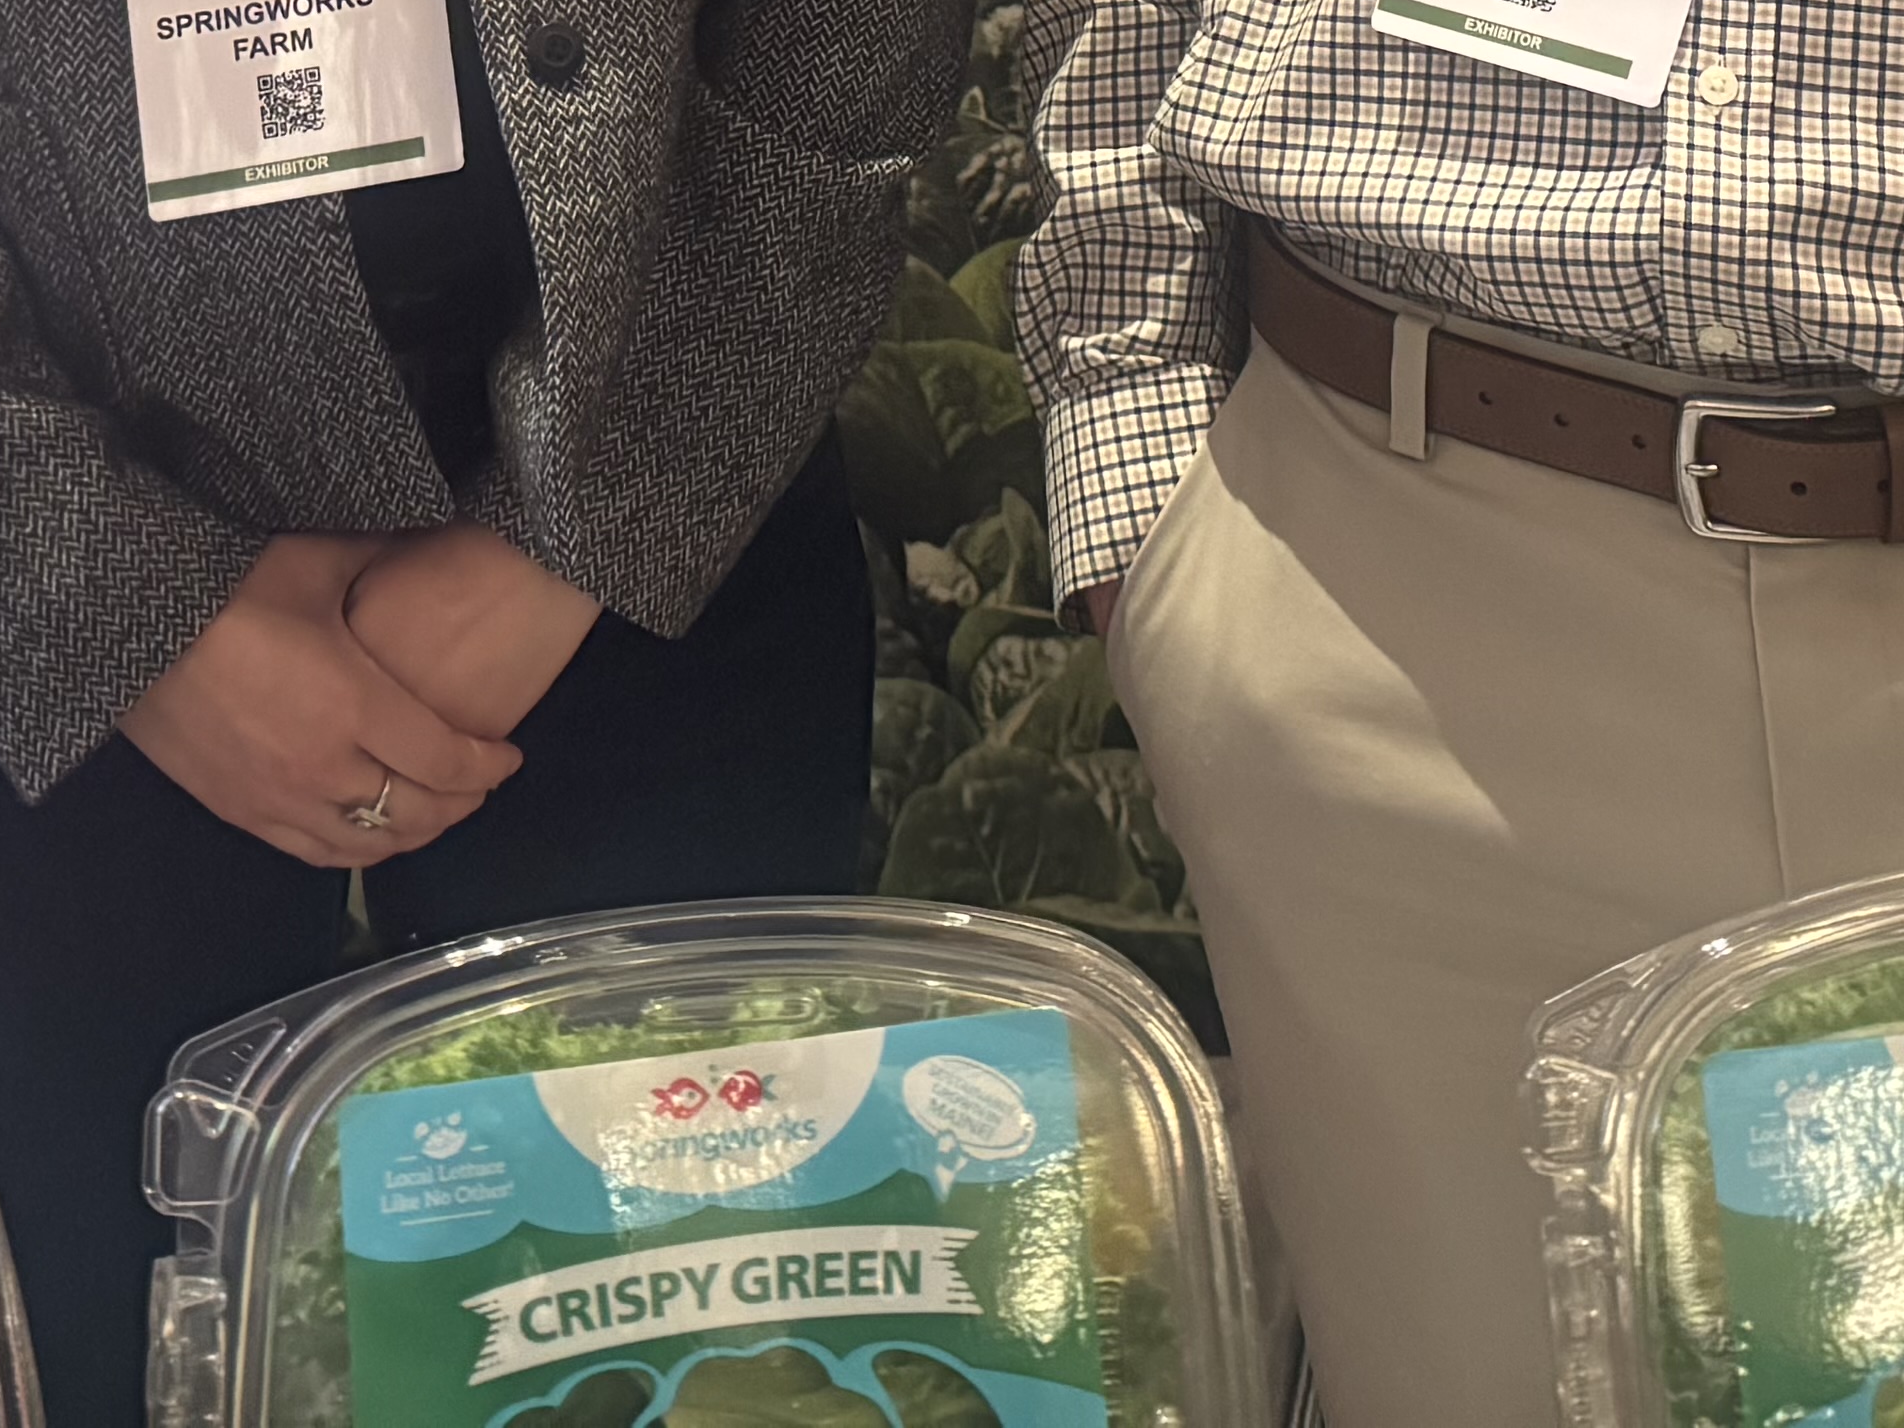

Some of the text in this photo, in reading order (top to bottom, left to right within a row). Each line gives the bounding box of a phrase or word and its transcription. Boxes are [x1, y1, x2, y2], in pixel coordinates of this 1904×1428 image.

[232, 28, 313, 61] FARM
[1464, 18, 1542, 50] EXHIBITOR
[244, 155, 329, 183] EXHIBITOR
[386, 1166, 434, 1189] Local
[381, 1194, 421, 1214] Like
[424, 1189, 452, 1208] No
[519, 1250, 923, 1343] CRISPY GREEN
